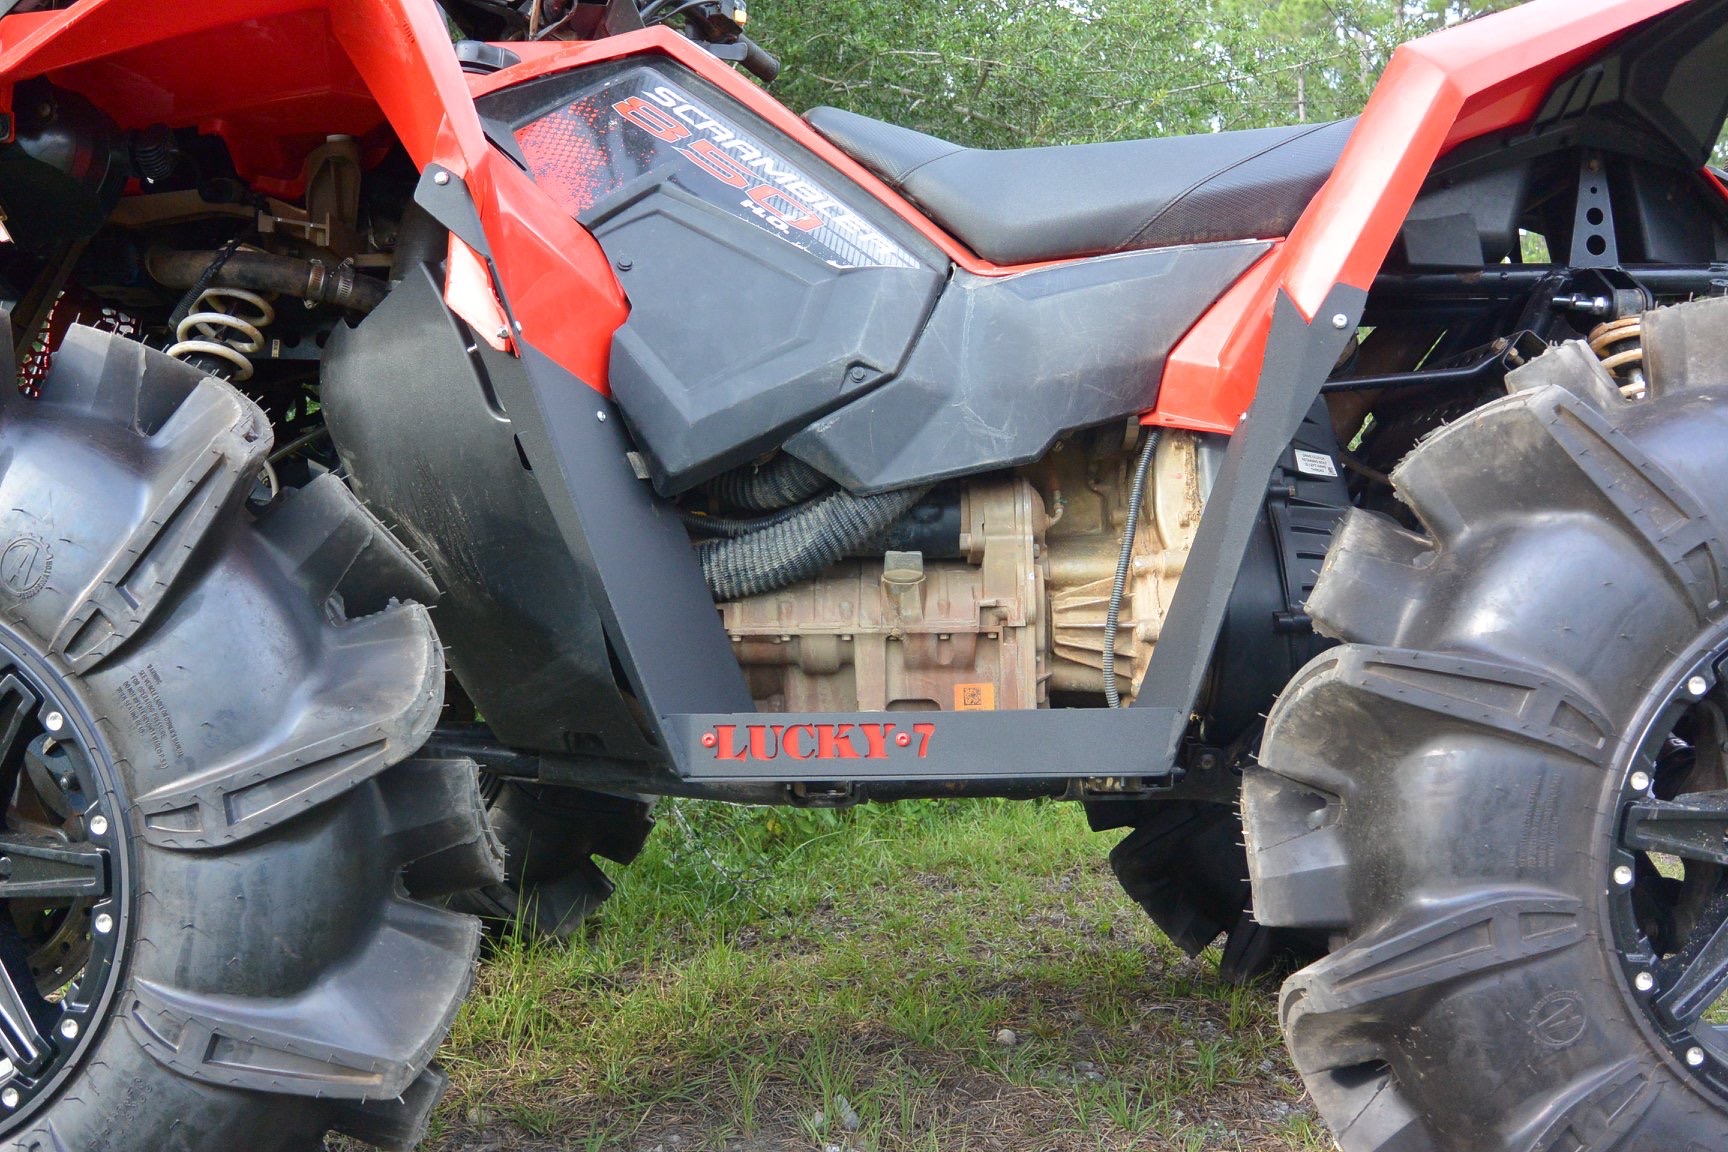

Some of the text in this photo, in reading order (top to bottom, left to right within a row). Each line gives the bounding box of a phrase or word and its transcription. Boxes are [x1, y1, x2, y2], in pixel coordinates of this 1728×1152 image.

[611, 96, 825, 232] 850
[641, 86, 899, 252] SCRAMBLER
[713, 723, 936, 762] LUCKY 7
